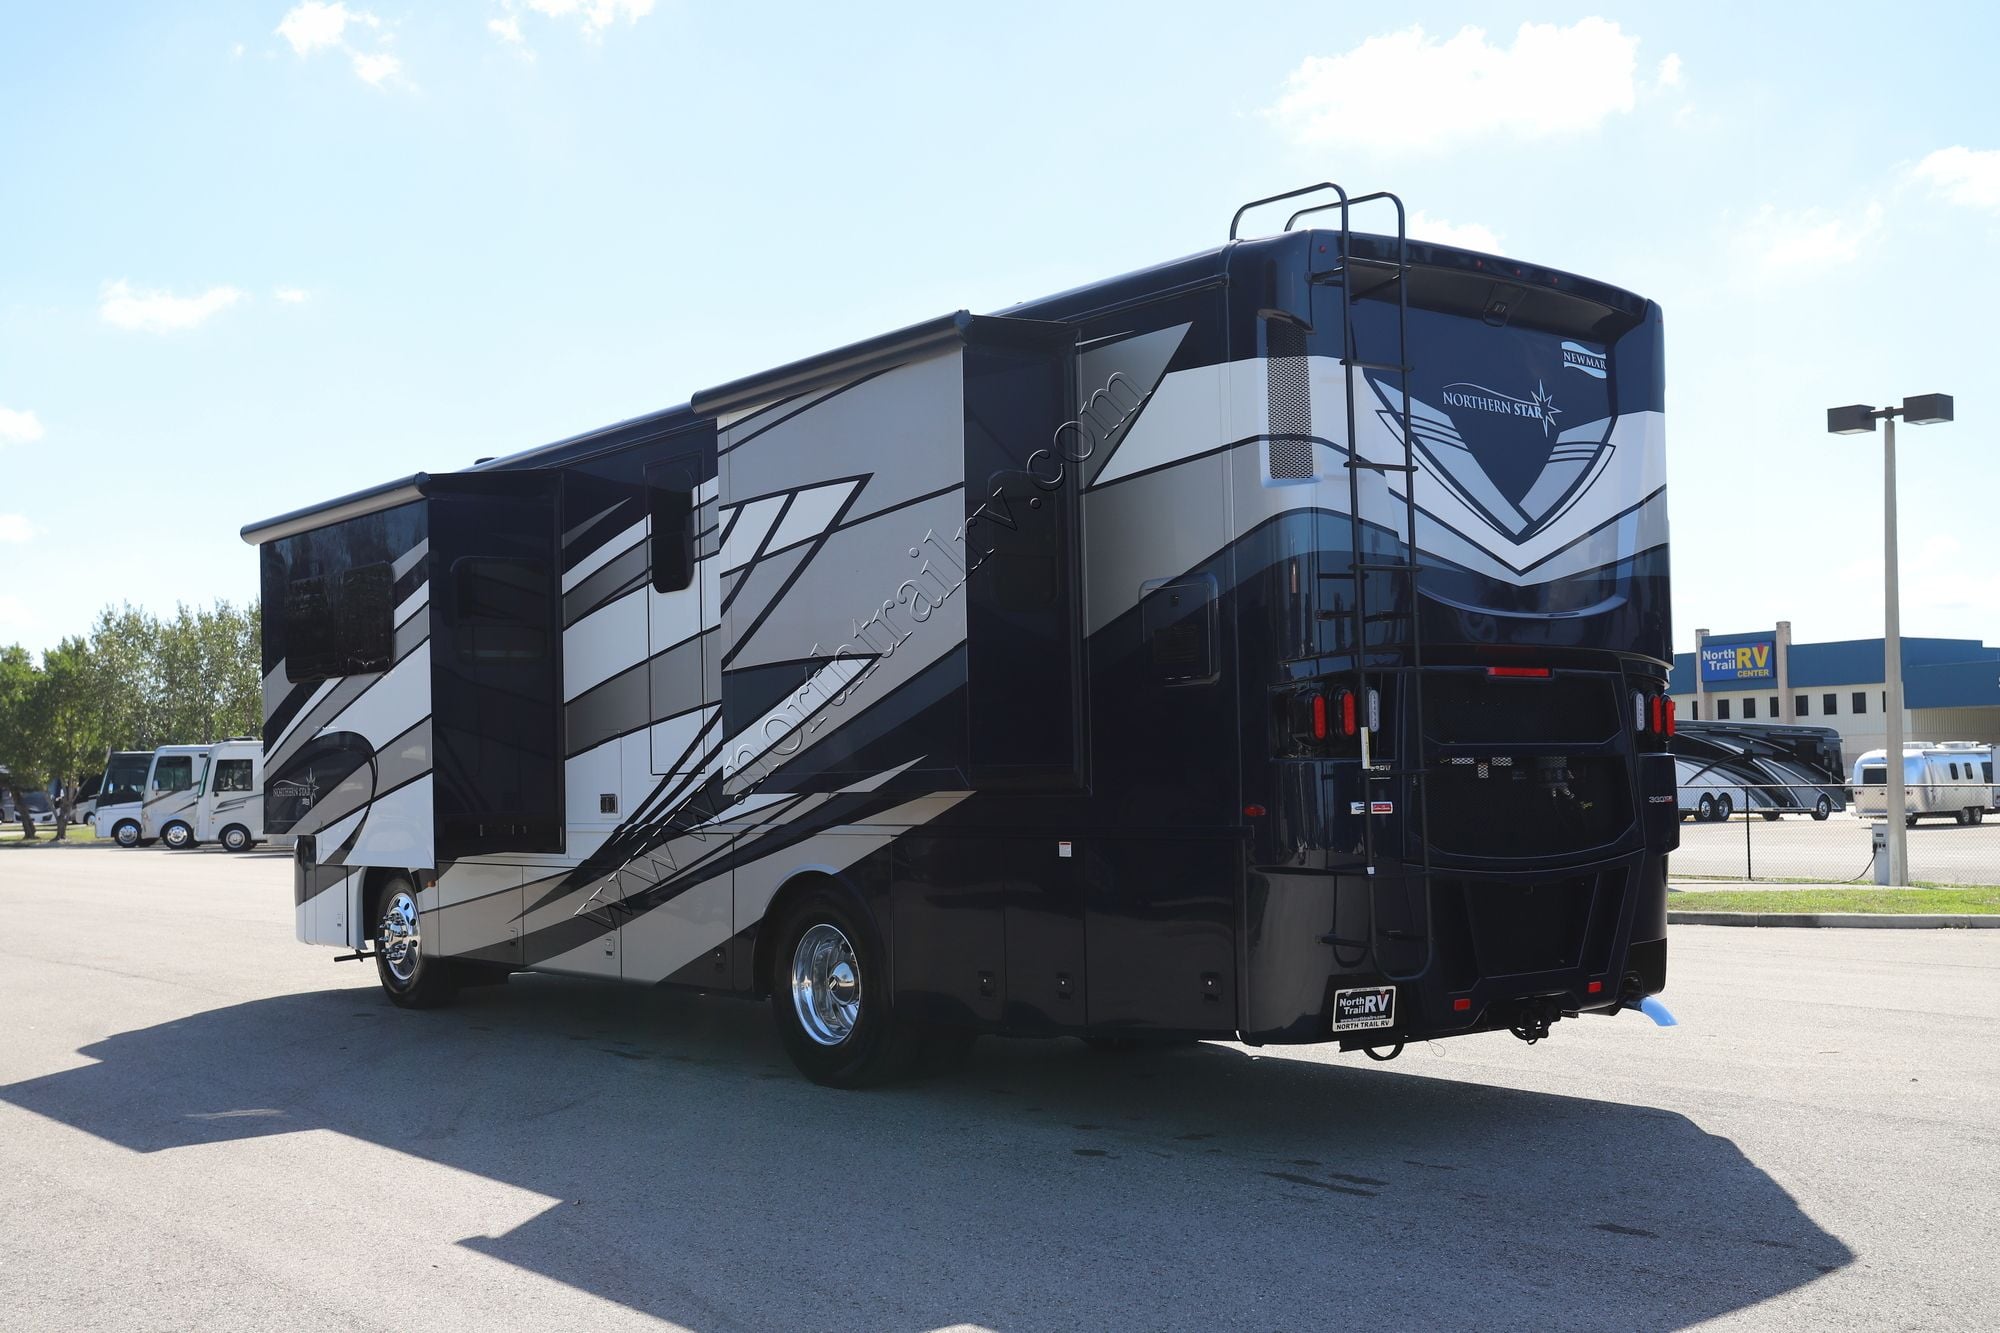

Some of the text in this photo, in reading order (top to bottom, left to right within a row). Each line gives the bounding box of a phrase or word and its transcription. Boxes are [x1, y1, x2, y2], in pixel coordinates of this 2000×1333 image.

[1563, 351, 1607, 370] NEWMAR
[1443, 391, 1544, 419] NORTHERN STAR
[1702, 649, 1735, 661] North
[1736, 646, 1770, 669] RV
[1708, 660, 1736, 671] Trail
[1737, 669, 1770, 678] CENTER
[1339, 996, 1365, 1007] North
[1365, 994, 1390, 1013] RV
[1344, 1005, 1364, 1015] Trail
[1336, 1019, 1390, 1030] NORTH TRAIL RV
